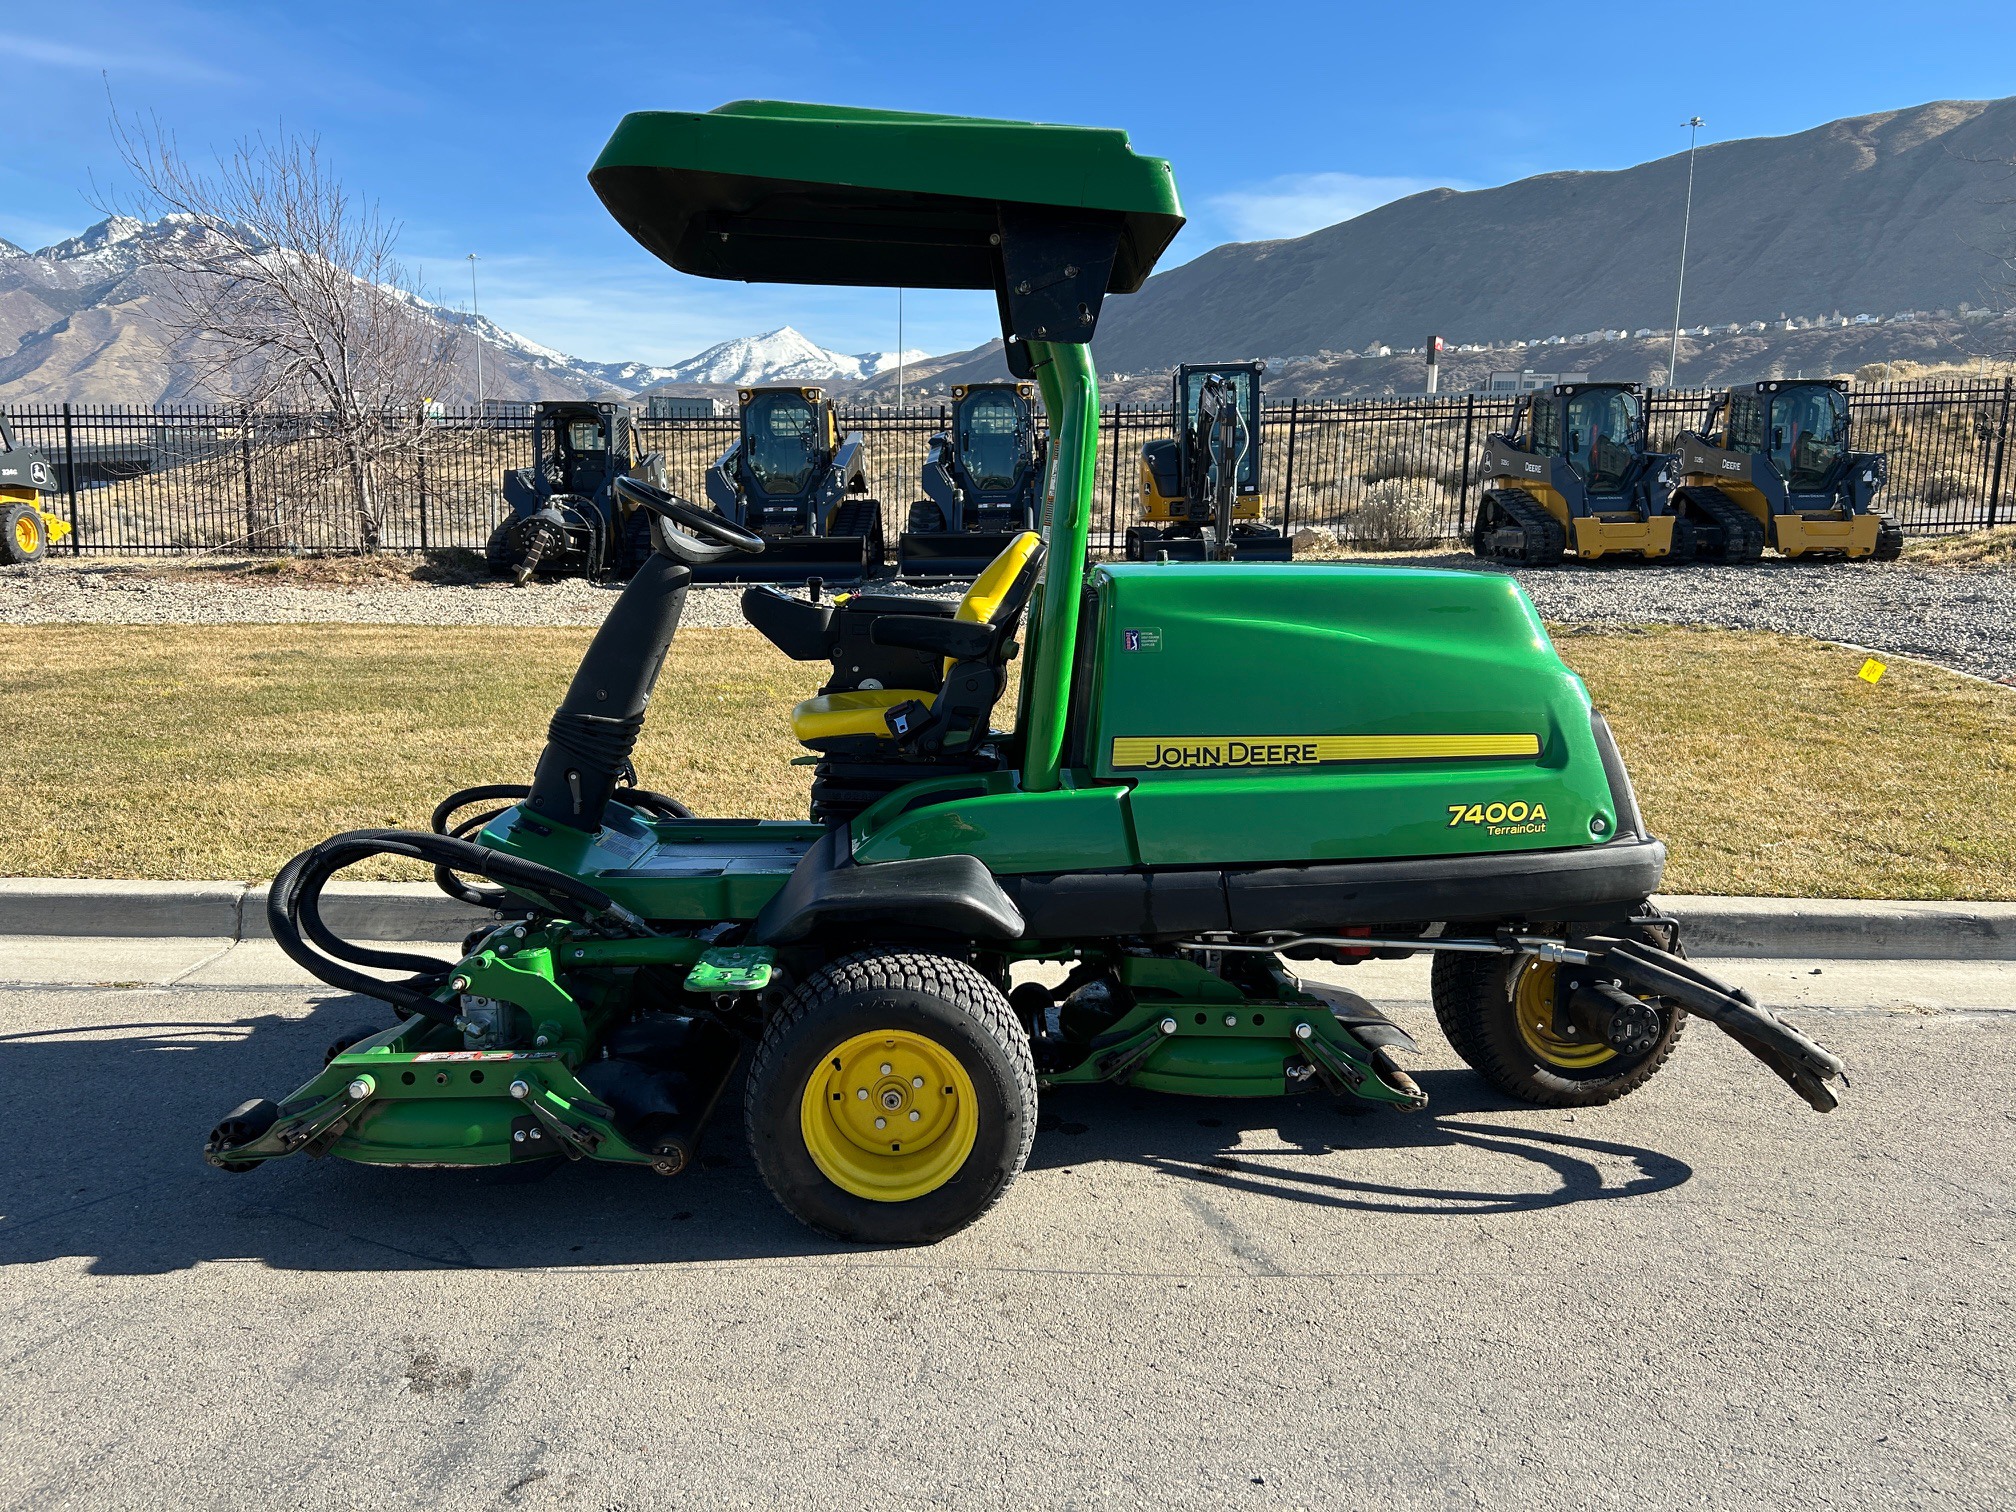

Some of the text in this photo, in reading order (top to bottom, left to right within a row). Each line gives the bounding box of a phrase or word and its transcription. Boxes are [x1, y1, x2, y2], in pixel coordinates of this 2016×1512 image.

[1524, 461, 1542, 474] DEERE
[1721, 459, 1741, 471] DEERE
[1146, 742, 1318, 767] JOHN DEERE
[1486, 822, 1546, 836] TerrainCut
